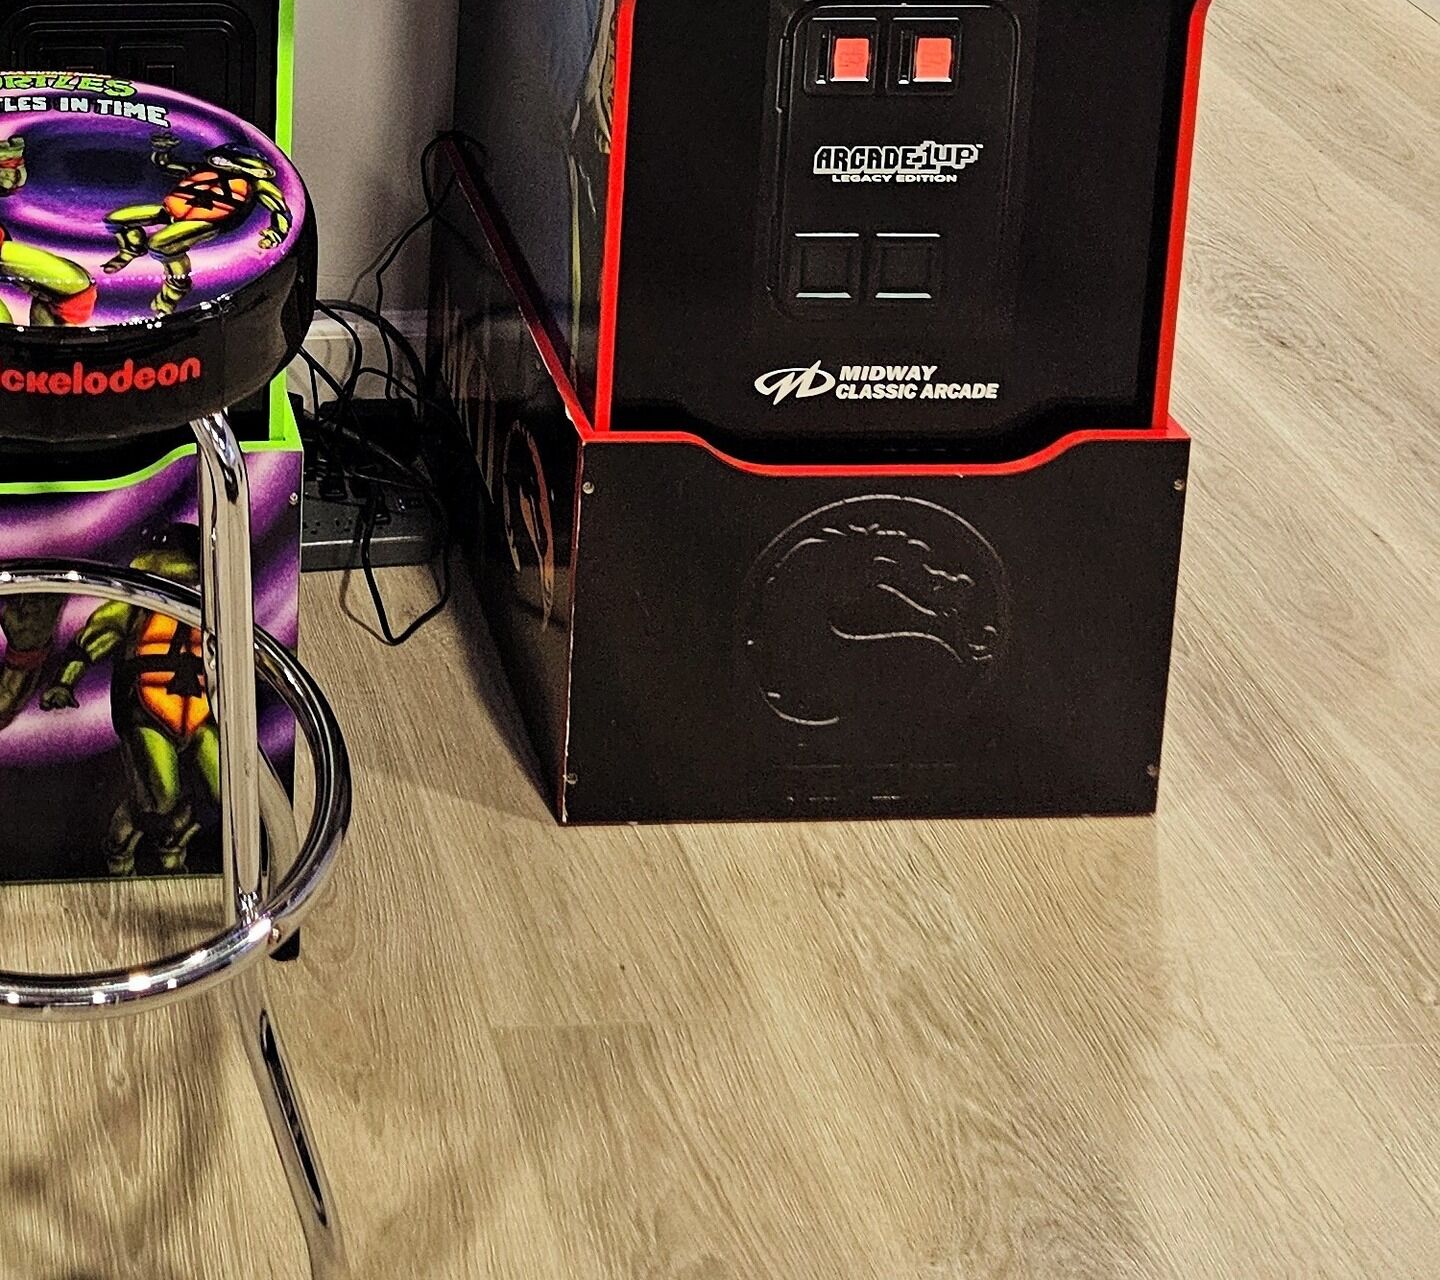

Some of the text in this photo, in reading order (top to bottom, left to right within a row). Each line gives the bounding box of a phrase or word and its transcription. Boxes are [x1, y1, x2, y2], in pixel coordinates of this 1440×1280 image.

[60, 97, 89, 113] IN
[96, 98, 170, 128] TIME
[832, 174, 958, 183] LEGACY EDITION
[839, 365, 938, 381] MIDWAY
[835, 383, 1000, 400] CLASSIC ARCADE
